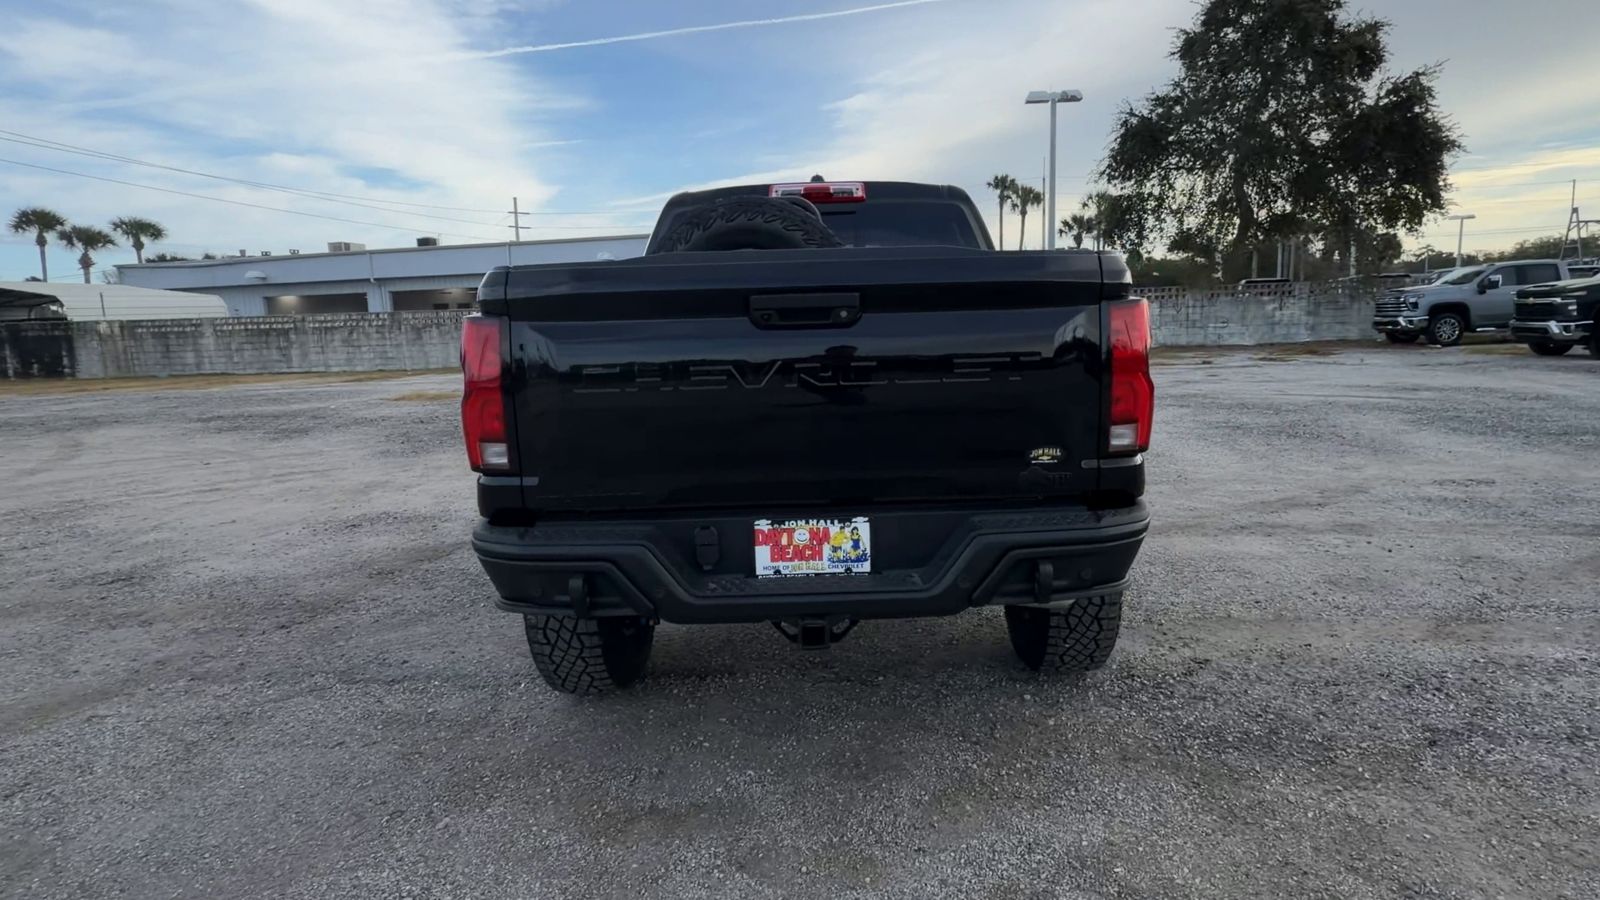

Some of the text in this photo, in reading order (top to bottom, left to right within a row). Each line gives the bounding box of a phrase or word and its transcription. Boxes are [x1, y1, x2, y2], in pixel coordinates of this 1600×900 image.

[1029, 447, 1062, 458] JON HALL
[784, 519, 840, 528] JON HALL
[753, 527, 830, 546] DAYTONA
[770, 545, 824, 563] BEACH
